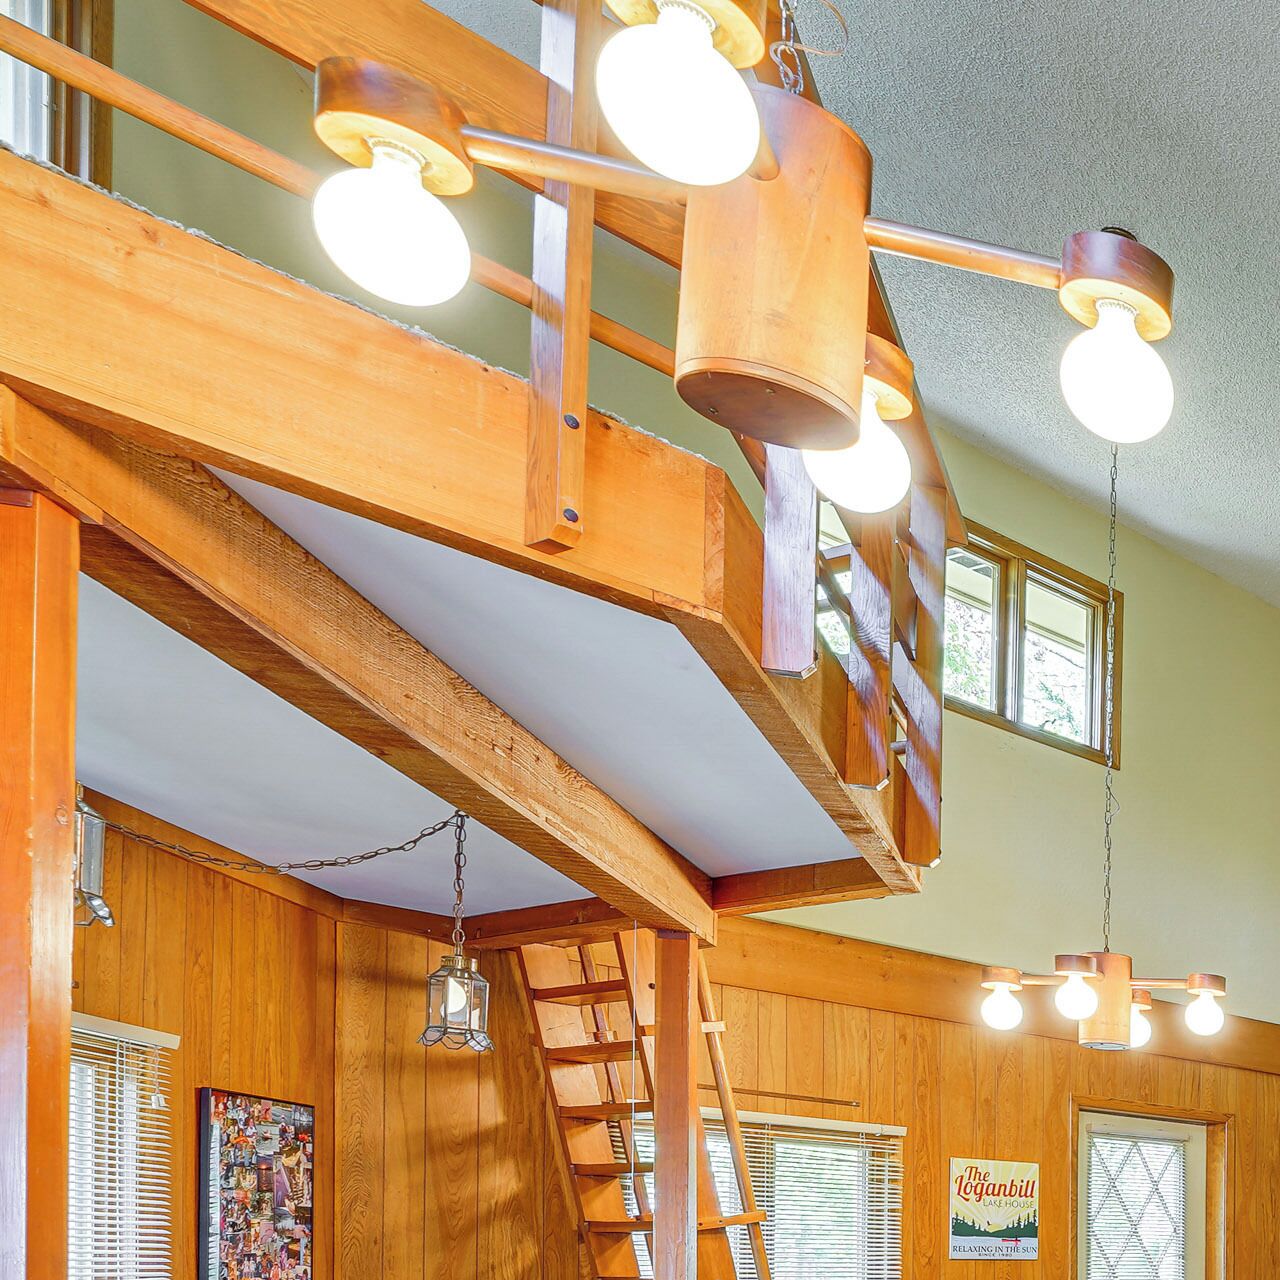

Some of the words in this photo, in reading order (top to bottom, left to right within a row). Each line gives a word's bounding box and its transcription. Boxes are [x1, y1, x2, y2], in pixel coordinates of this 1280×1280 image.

[965, 1166, 990, 1182] The
[955, 1175, 1036, 1202] Loganbill
[983, 1199, 1003, 1208] LAKE
[1005, 1200, 1034, 1208] HOUSE
[952, 1245, 993, 1253] RELAXING
[1021, 1246, 1037, 1254] SUN
